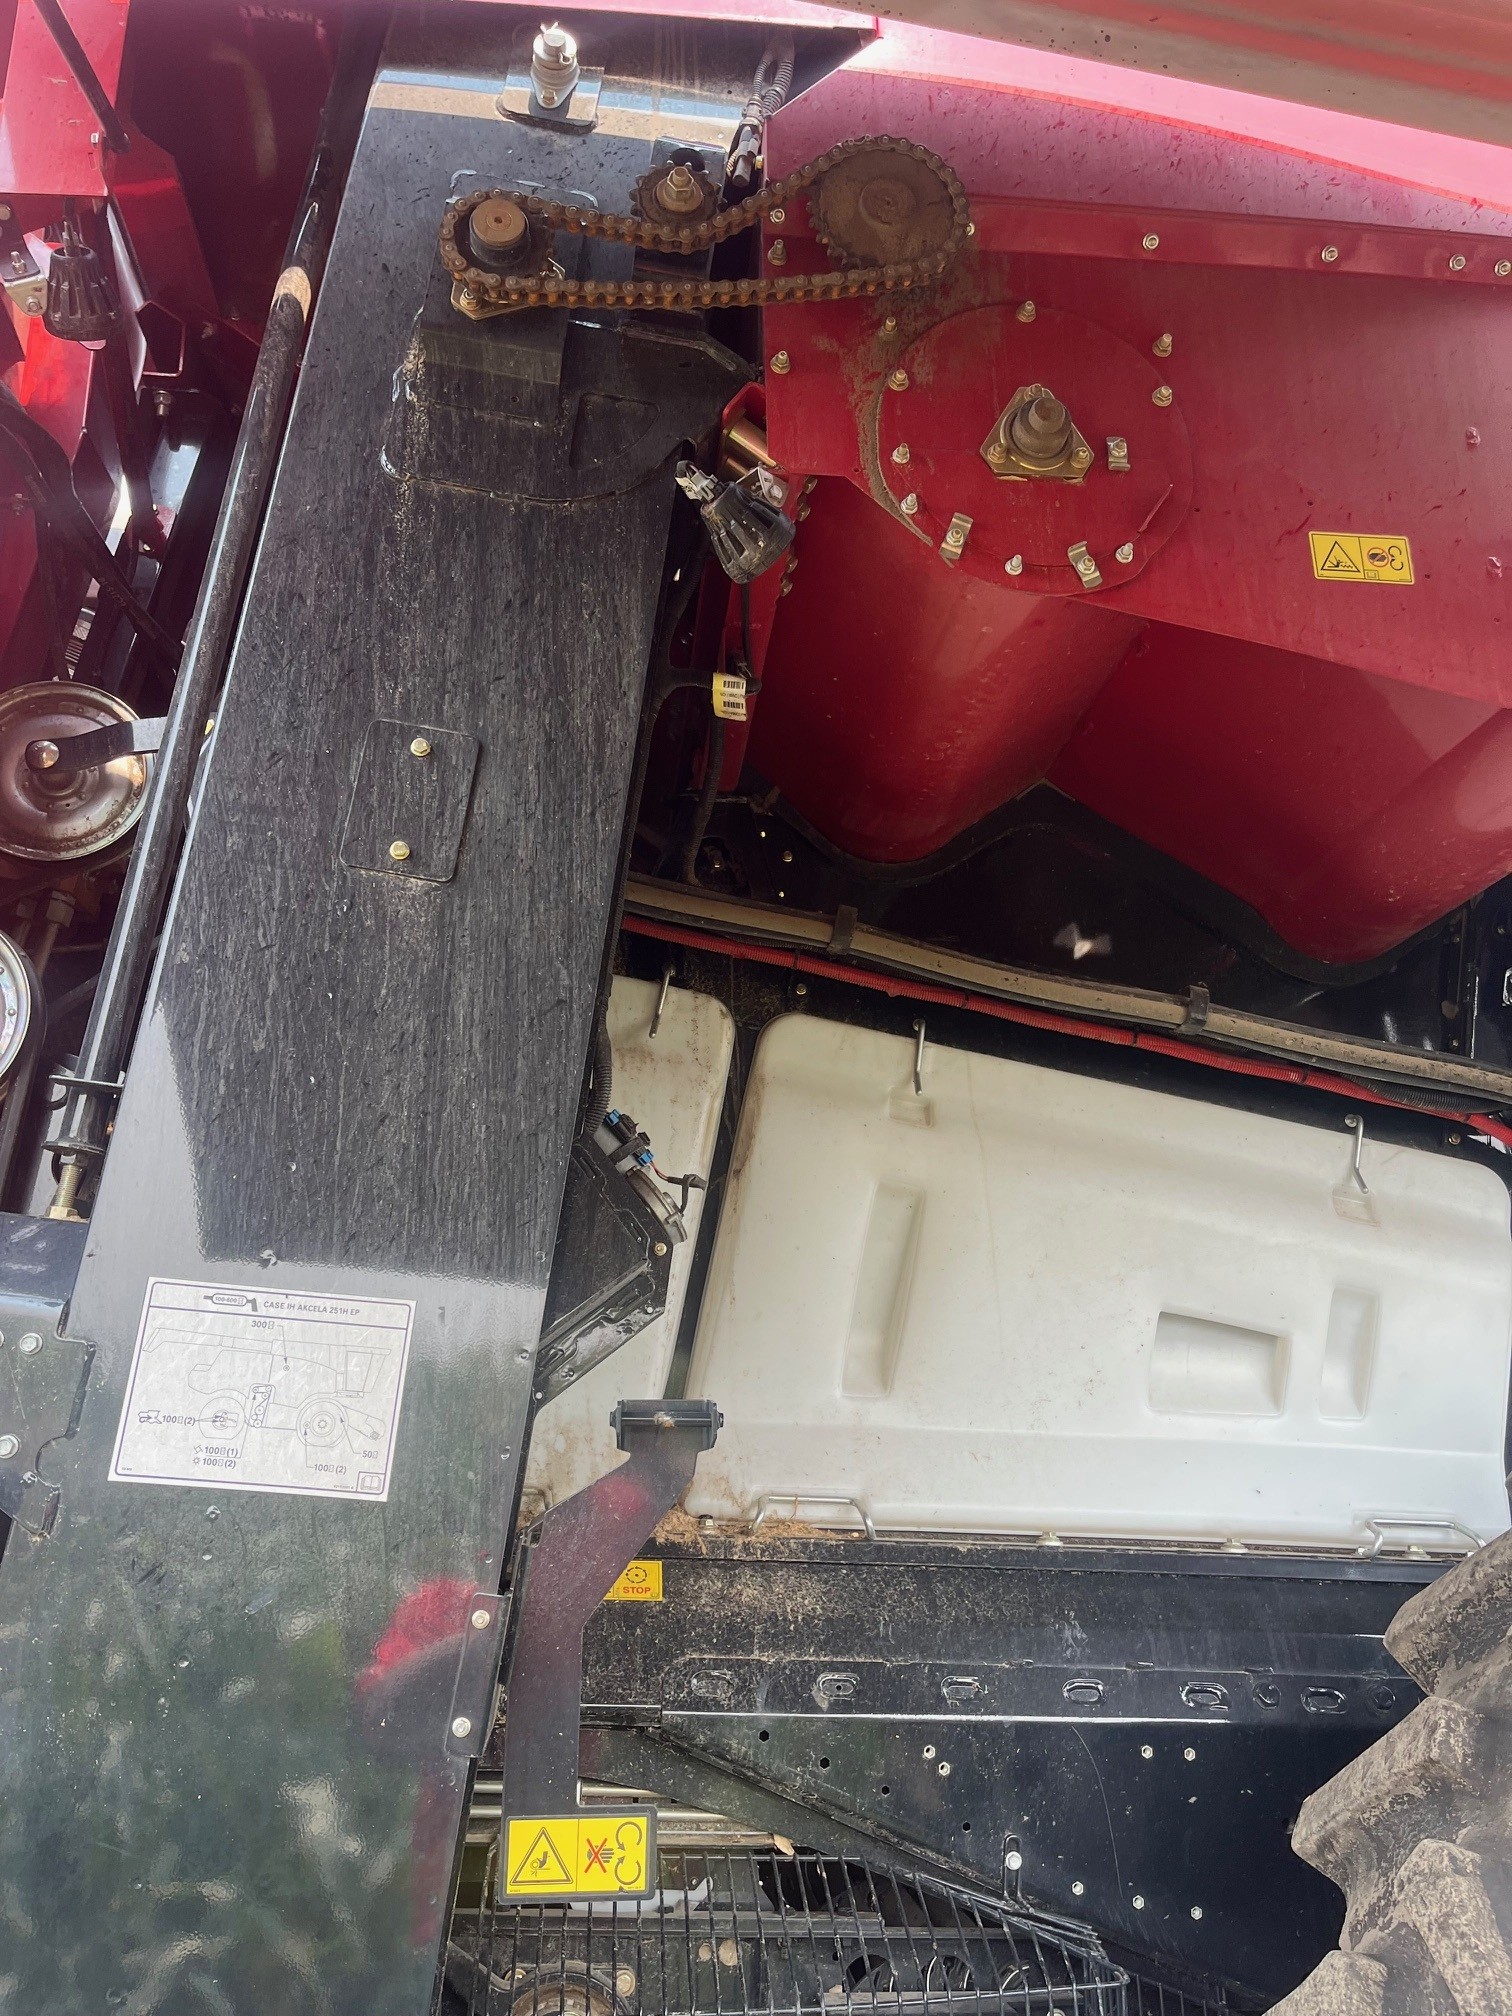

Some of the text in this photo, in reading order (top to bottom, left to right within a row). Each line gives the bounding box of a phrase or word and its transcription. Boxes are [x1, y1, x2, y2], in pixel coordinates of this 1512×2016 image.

[263, 1300, 360, 1316] CASE IH AKCELA 251H EP
[622, 1586, 651, 1594] STOP
